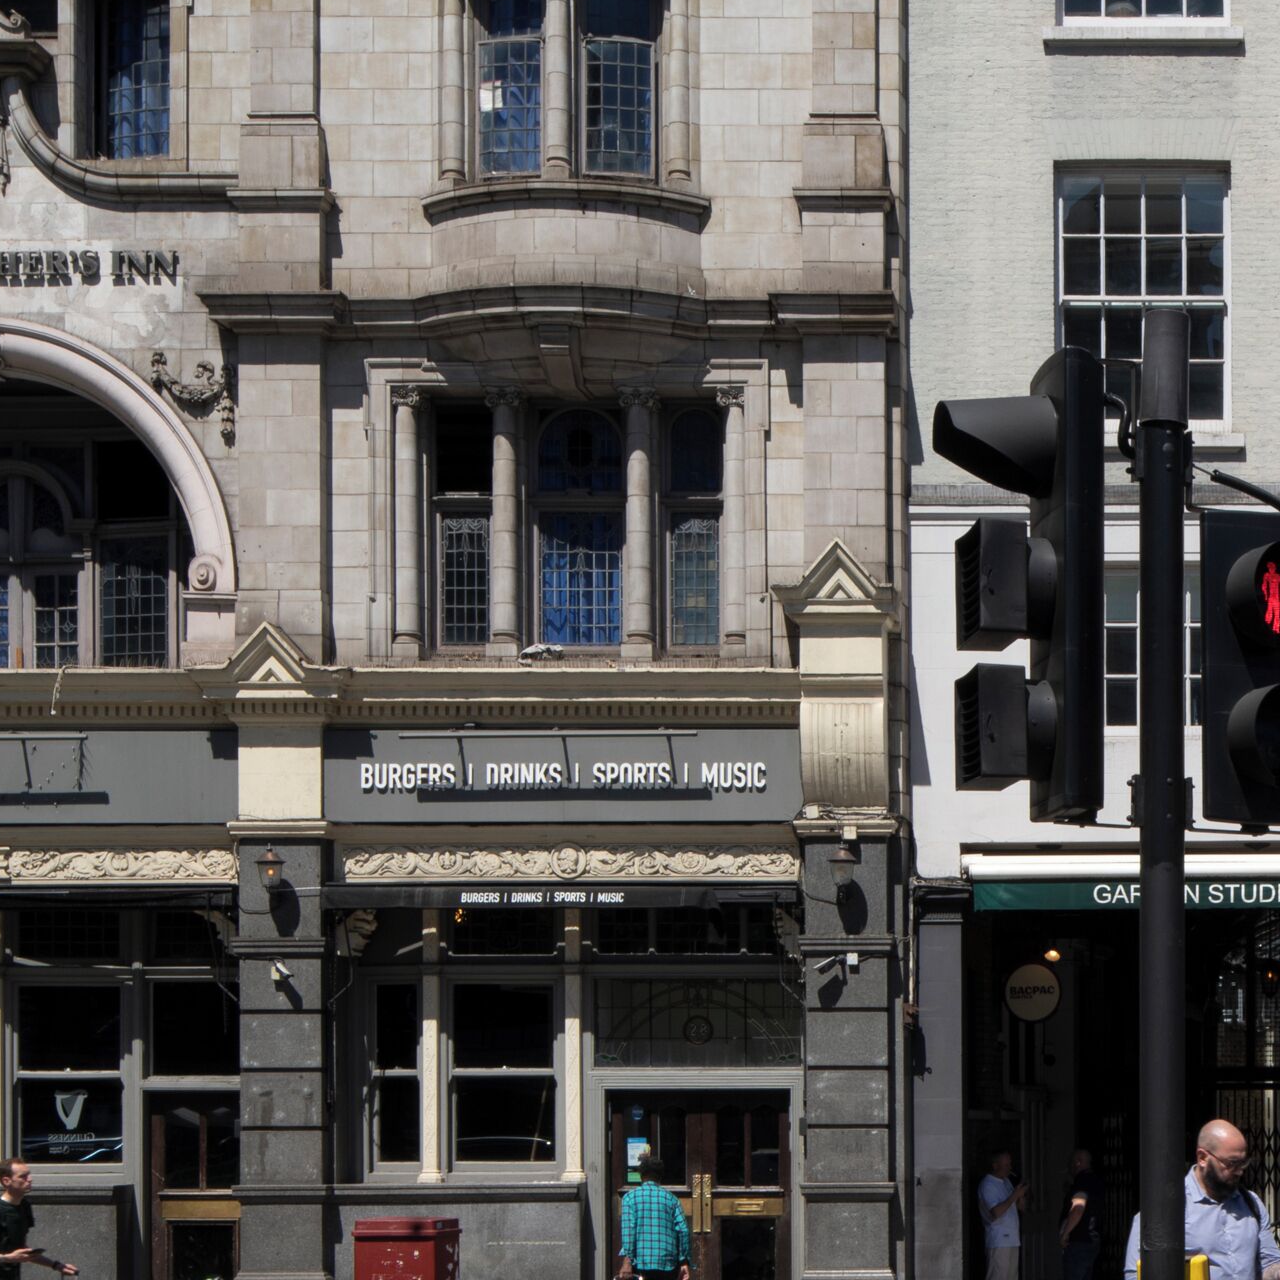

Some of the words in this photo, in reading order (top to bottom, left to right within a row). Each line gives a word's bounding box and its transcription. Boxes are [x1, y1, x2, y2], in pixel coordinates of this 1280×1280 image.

[110, 250, 180, 277] INN
[360, 763, 456, 790] BURGERS
[486, 762, 562, 786] DRINKS
[592, 762, 671, 786] SPORTS
[701, 762, 767, 788] MUSIC
[461, 891, 500, 903] BURGERS
[511, 891, 543, 903] DRINKS
[554, 891, 586, 903] SPORTS
[597, 892, 624, 903] MUSIC
[1009, 986, 1055, 995] BACPAC
